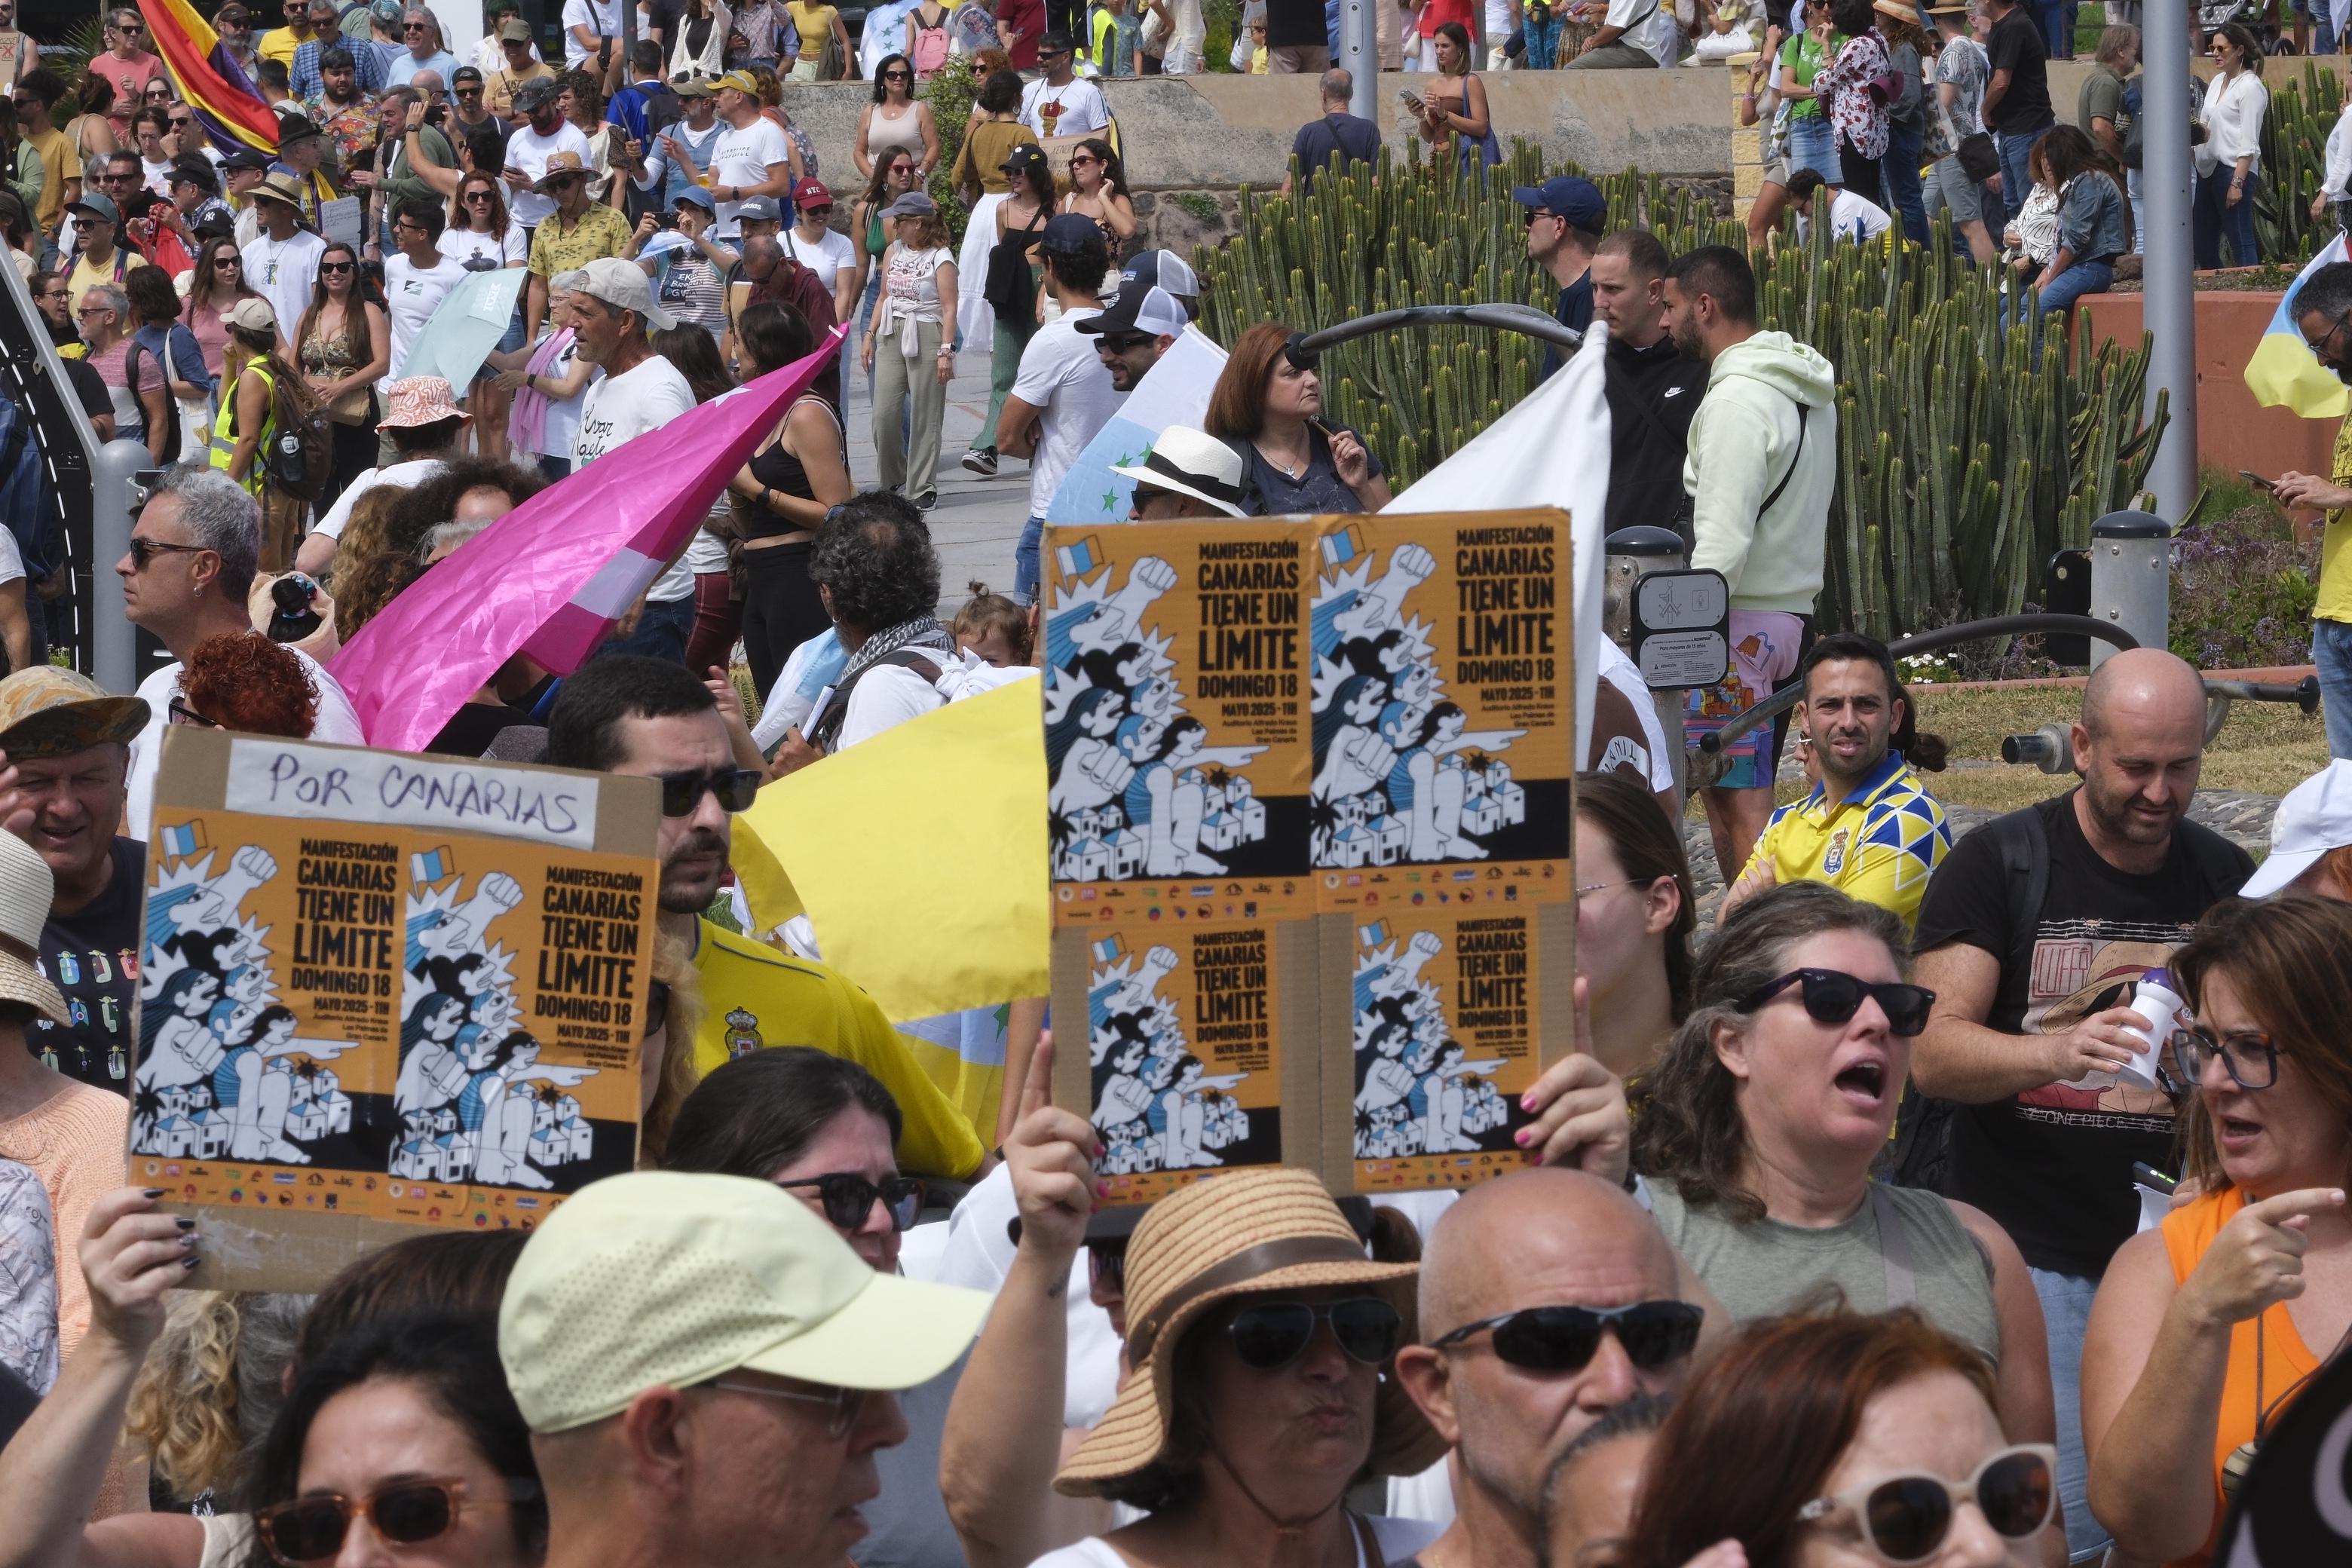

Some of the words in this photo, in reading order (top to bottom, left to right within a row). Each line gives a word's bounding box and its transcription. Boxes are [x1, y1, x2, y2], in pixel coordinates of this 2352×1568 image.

[806, 186, 821, 195] NYC
[204, 211, 216, 221] NY
[740, 202, 762, 210] adidas
[1456, 523, 1554, 546] MANIFESTACIÓN
[1199, 538, 1299, 560] MANIFESTACIÓN
[1456, 547, 1554, 576] CANARIAS
[1198, 562, 1299, 590] CANARIAS
[1456, 578, 1519, 611] TIENE
[1524, 577, 1554, 609] UN
[1198, 593, 1263, 626] TIENE
[1267, 593, 1298, 625] UN
[1457, 608, 1554, 657] LÍMITE
[1198, 623, 1298, 672] LÍMITE
[1457, 660, 1533, 684] DOMINGO
[1536, 658, 1554, 681] 18
[1198, 674, 1276, 698] DOMINGO
[1279, 675, 1297, 697] 18
[1481, 688, 1507, 702] MAYO
[1509, 686, 1533, 700] 2025
[1540, 686, 1554, 699] 11H
[1221, 703, 1248, 716] MAYO
[1250, 703, 1276, 716] 2025
[1282, 702, 1297, 715] 11H
[268, 752, 352, 807] POR
[379, 764, 579, 835] CANARIAS
[300, 838, 399, 862] MANIFESTACIÓN
[297, 858, 397, 893] CANARIAS
[547, 865, 642, 893] MANIFESTACIÓN
[296, 888, 360, 924] TIENE
[363, 894, 395, 926] UN
[543, 885, 641, 922] CANARIAS
[541, 914, 605, 952] TIENE
[608, 922, 639, 955] UN
[1194, 928, 1265, 946] MANIFESTACIÓN
[1456, 916, 1526, 933] MANIFESTACIÓN
[292, 918, 394, 970] LÍMITE
[1456, 931, 1526, 954] CANARIAS
[1194, 945, 1266, 967] CANARIAS
[1456, 954, 1502, 978] TIENE
[1505, 952, 1527, 975] UN
[291, 967, 369, 996] DOMINGO
[372, 974, 390, 997] 18
[537, 946, 635, 999] LÍMITE
[1195, 967, 1241, 991] TIENE
[1245, 966, 1266, 988] UN
[314, 996, 341, 1011] MAYO
[342, 998, 368, 1013] 2025
[375, 1002, 390, 1015] 11H
[535, 994, 611, 1024] DOMINGO
[614, 1002, 632, 1025] 18
[1458, 1009, 1513, 1028] DOMINGO
[1514, 1009, 1527, 1025] 18
[557, 1024, 585, 1038] MAYO
[586, 1026, 609, 1041] 2025
[615, 1029, 630, 1043] 11H
[1196, 1023, 1253, 1043] DOMINGO
[1254, 1022, 1268, 1039] 18
[2045, 1110, 2075, 1126] ONE
[2082, 1113, 2127, 1129] PIECE
